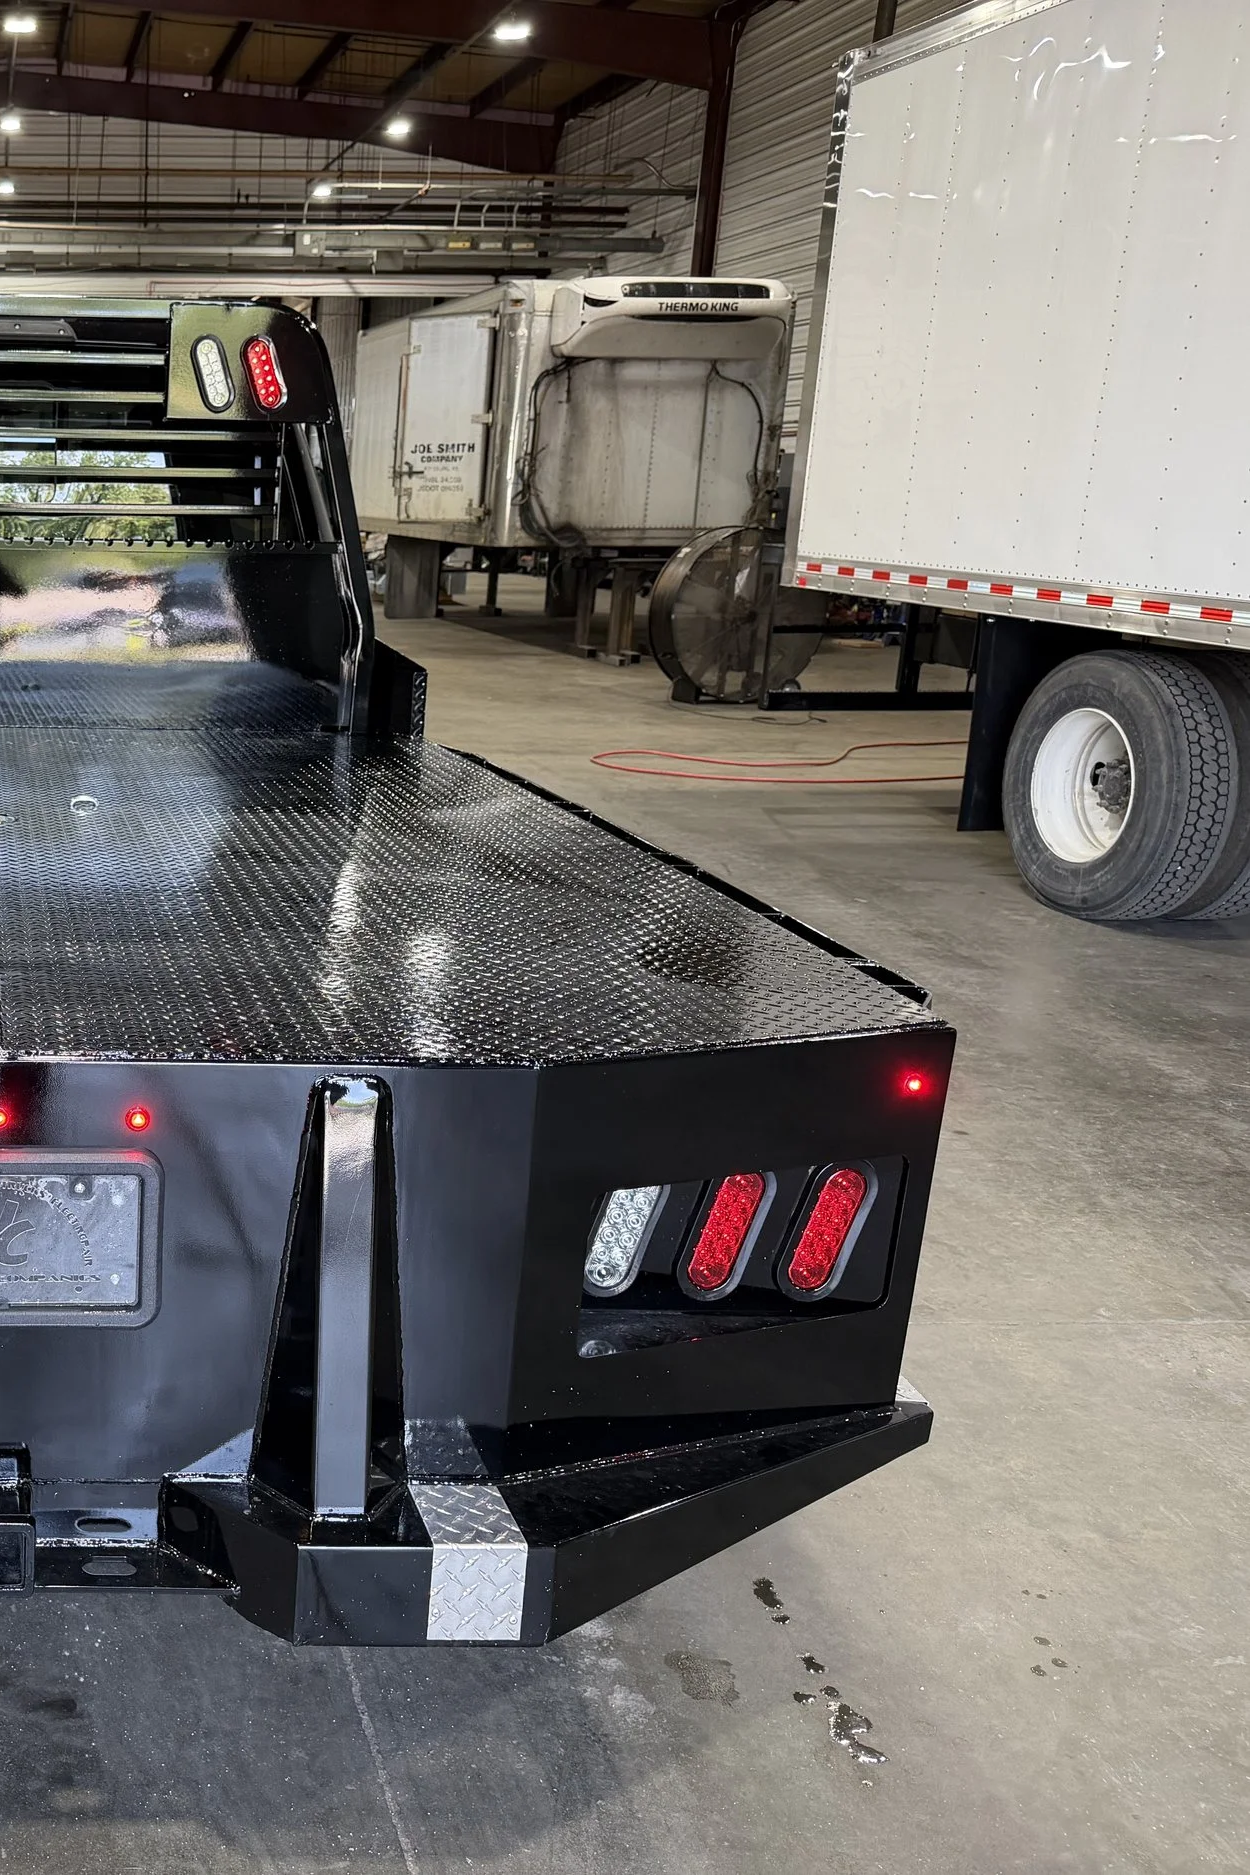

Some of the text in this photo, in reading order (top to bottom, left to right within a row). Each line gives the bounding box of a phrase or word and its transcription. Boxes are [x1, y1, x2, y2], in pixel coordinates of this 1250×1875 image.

[658, 302, 739, 312] THERMO KING
[410, 442, 476, 454] JOE SMITH
[420, 455, 463, 463] COMPANY
